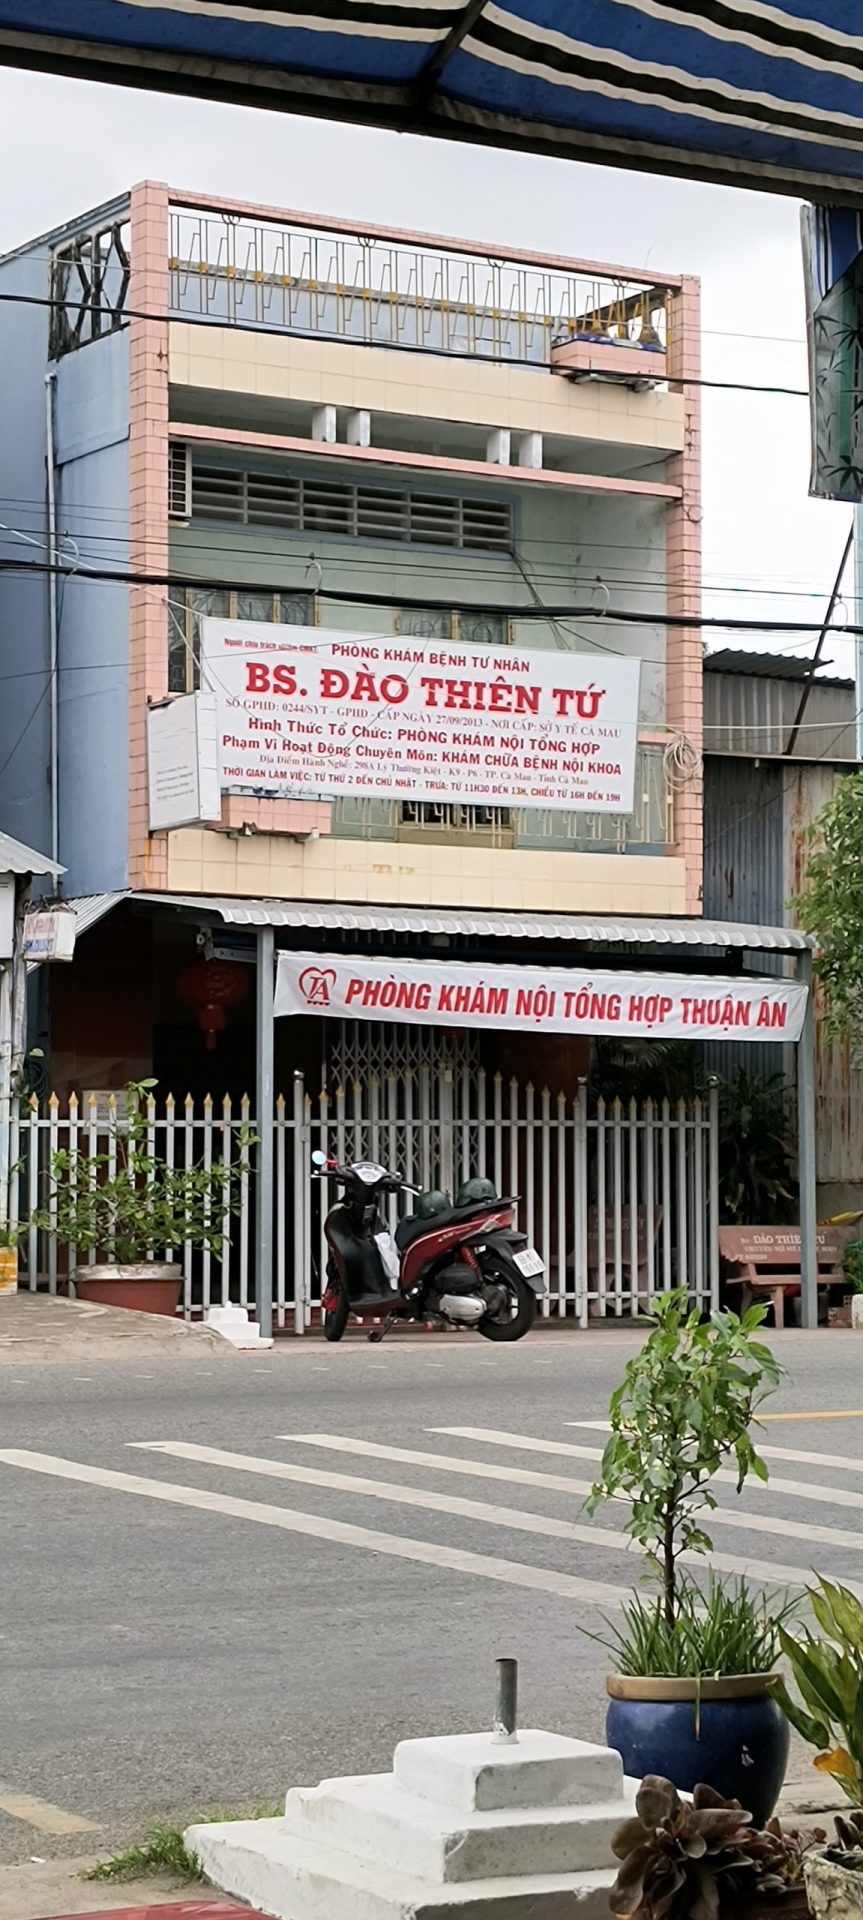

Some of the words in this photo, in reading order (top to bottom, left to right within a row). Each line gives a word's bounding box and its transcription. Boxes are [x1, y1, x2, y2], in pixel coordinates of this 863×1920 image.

[331, 643, 379, 659] PHÒNG
[383, 646, 425, 663] KHÁM
[429, 650, 467, 668] BỆNH
[471, 655, 491, 669] TƯ
[493, 658, 530, 673] NHÂN
[245, 661, 308, 697] BS.
[319, 662, 410, 704] ĐÀO
[420, 675, 542, 715] THIÊN
[552, 682, 607, 719] TỨ
[225, 694, 240, 708] SỐ
[242, 700, 280, 712] GPHD:
[281, 702, 329, 716] 0244/SYT
[336, 707, 369, 719] GPHD
[377, 706, 400, 721] CẤP
[402, 710, 434, 725] NGÀY
[435, 714, 484, 728] 27/09/2013
[491, 718, 510, 730] NƠI
[511, 717, 537, 731] CẤP:
[555, 723, 563, 734] Y
[564, 720, 578, 735] TẾ
[580, 724, 595, 736] CÀ
[597, 727, 622, 738] MAU
[222, 735, 260, 751] Phạm
[264, 738, 278, 750] Vi
[282, 740, 313, 755] Hoạt
[317, 742, 351, 757] Động
[355, 745, 402, 761] Chuyên
[406, 748, 438, 762] Môn:
[441, 749, 481, 765] KHÁM
[484, 751, 519, 768] CHỮA
[523, 755, 558, 771] BỆNH
[562, 758, 584, 773] NỘI
[587, 761, 622, 776] KHOA
[248, 717, 282, 732] Hình
[287, 719, 323, 735] Thức
[328, 721, 347, 737] Tổ
[352, 725, 392, 740] Chức:
[397, 728, 447, 744] PHÒNG
[452, 731, 495, 748] KHÁM
[499, 735, 524, 751] NỘI
[529, 733, 567, 753] TỔNG
[571, 741, 601, 756] HỢP
[222, 766, 244, 777] THỜI
[246, 768, 266, 779] GIAN
[268, 768, 288, 780] LÀM
[289, 770, 312, 782] VIỆC:
[347, 775, 354, 784] 2
[356, 772, 373, 785] ĐẾN
[395, 777, 417, 789] NHẬT
[464, 782, 490, 793] 11H30
[570, 789, 585, 800] 16H
[586, 789, 604, 801] ĐẾN
[605, 791, 621, 802] 19H
[259, 754, 275, 765] Địa
[302, 756, 326, 767] Hành
[355, 761, 375, 771] 298A
[448, 767, 461, 777] K9
[467, 769, 478, 778] P6
[484, 770, 500, 779] TP.
[513, 772, 532, 782] Mau
[571, 775, 589, 785] Mau
[344, 974, 432, 1011] PHÒNG
[437, 980, 509, 1015] KHÁM
[515, 984, 556, 1023] NỘI
[563, 982, 622, 1021] TỔNG
[628, 993, 674, 1028] HỢP
[680, 994, 752, 1031] THUẬN
[756, 996, 788, 1028] ÂN
[775, 1232, 803, 1244] THIÊ
